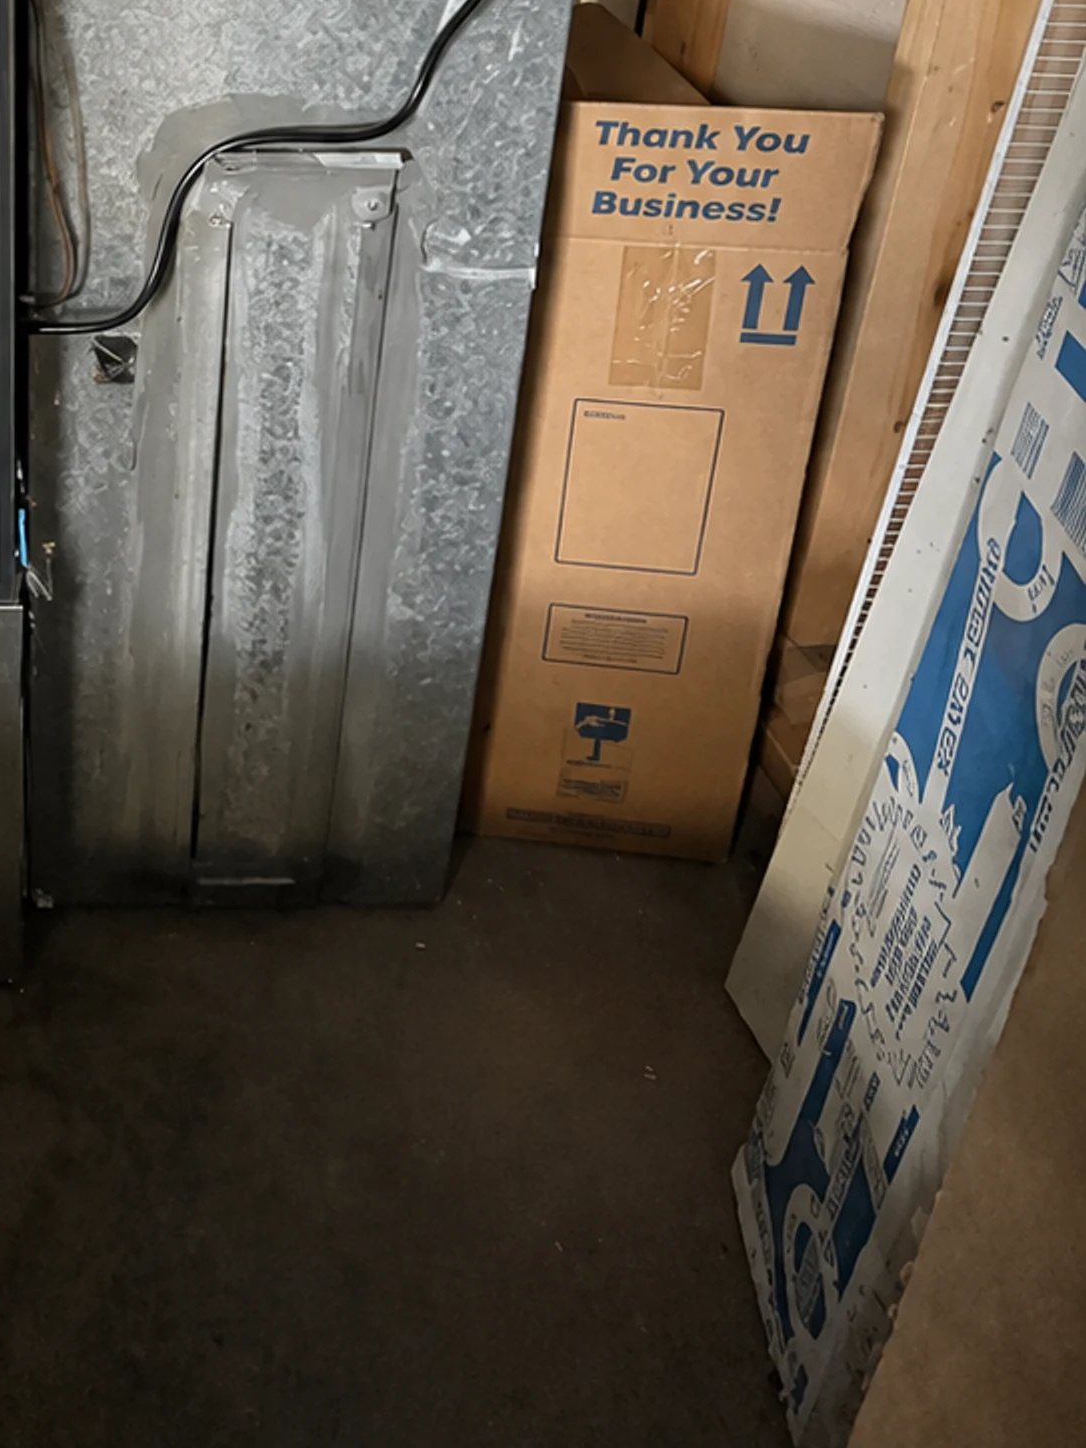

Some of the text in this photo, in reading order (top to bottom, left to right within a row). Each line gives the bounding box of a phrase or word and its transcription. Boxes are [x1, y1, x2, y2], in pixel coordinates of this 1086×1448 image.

[596, 120, 810, 154] Thank You
[610, 157, 780, 189] For Your
[592, 190, 781, 223] Business!
